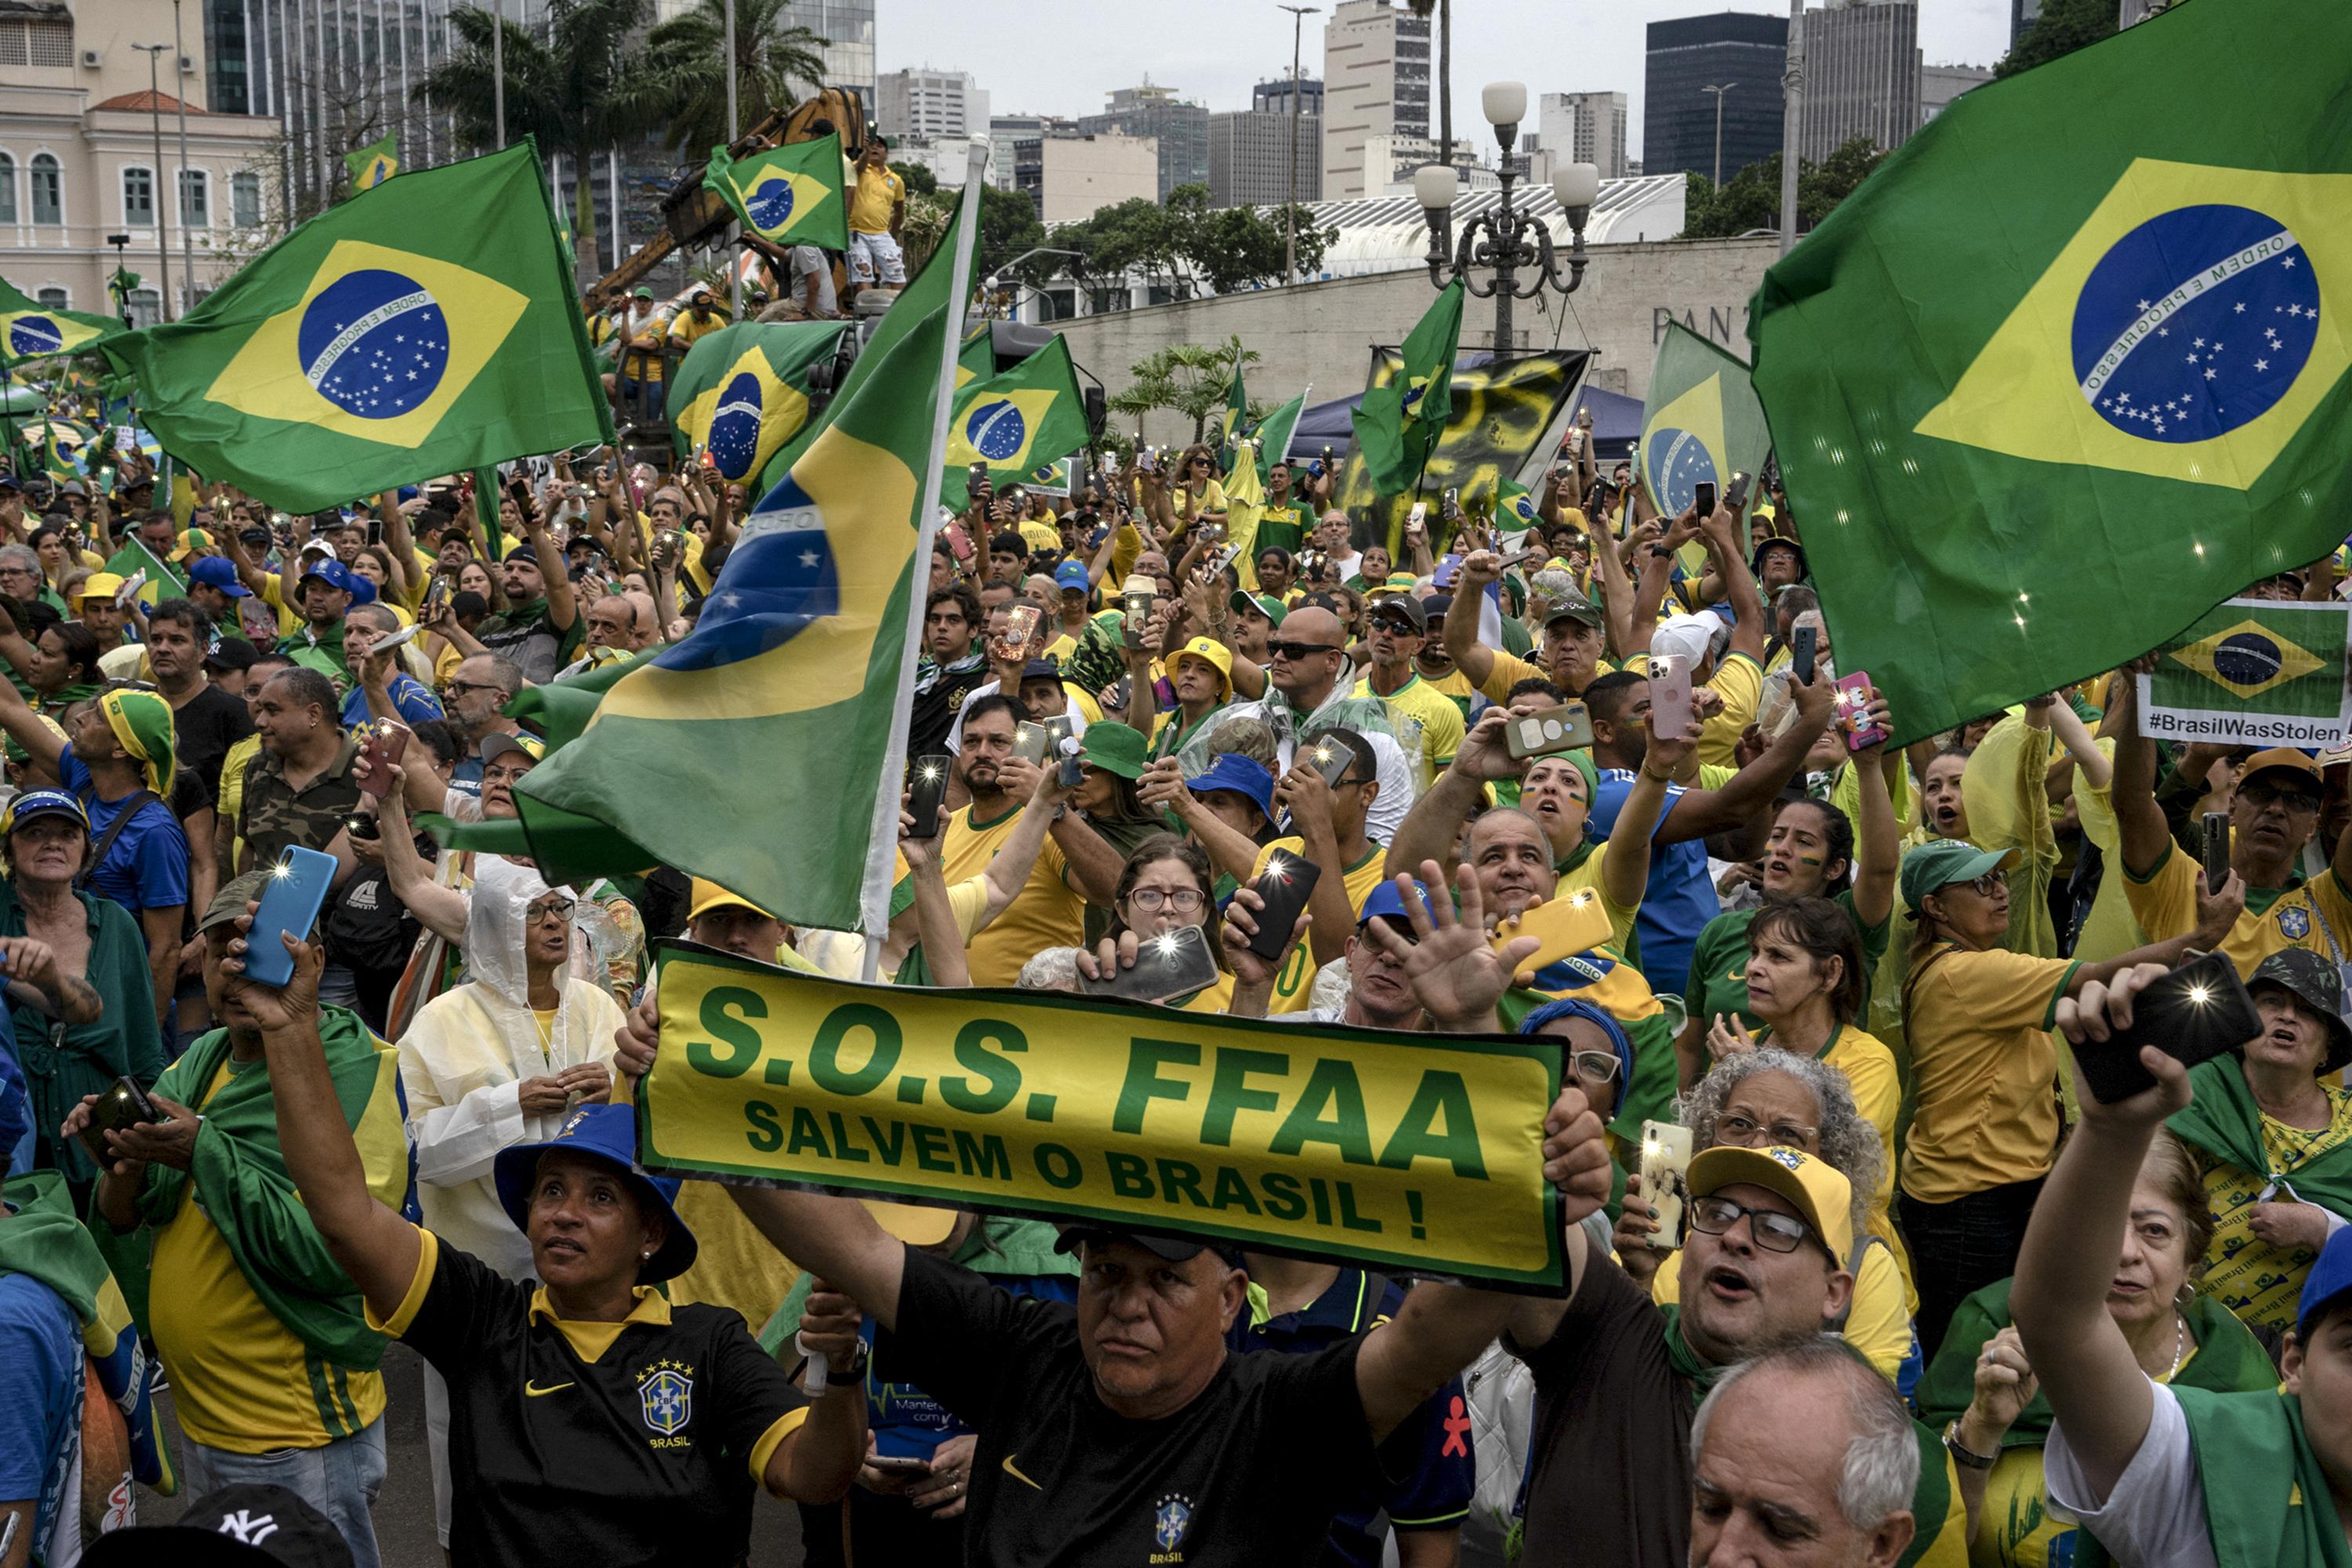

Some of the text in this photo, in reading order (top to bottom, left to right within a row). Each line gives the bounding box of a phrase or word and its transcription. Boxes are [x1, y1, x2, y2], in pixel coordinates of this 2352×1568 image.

[1652, 306, 1749, 346] PAN
[207, 641, 222, 655] NY
[2150, 713, 2341, 742] #BrasilWasStolen
[686, 985, 1490, 1181] S.O.S. FFAA
[744, 1100, 1012, 1181] SALVEM
[1033, 1142, 1083, 1189] O
[1104, 1150, 1383, 1234] BRASIL
[2214, 1265, 2246, 1287] Brasil
[658, 1397, 675, 1406] CBF
[913, 1413, 940, 1422] com
[649, 1436, 691, 1449] BRASIL
[218, 1509, 279, 1547] NY
[1149, 1552, 1185, 1565] BRASIL
